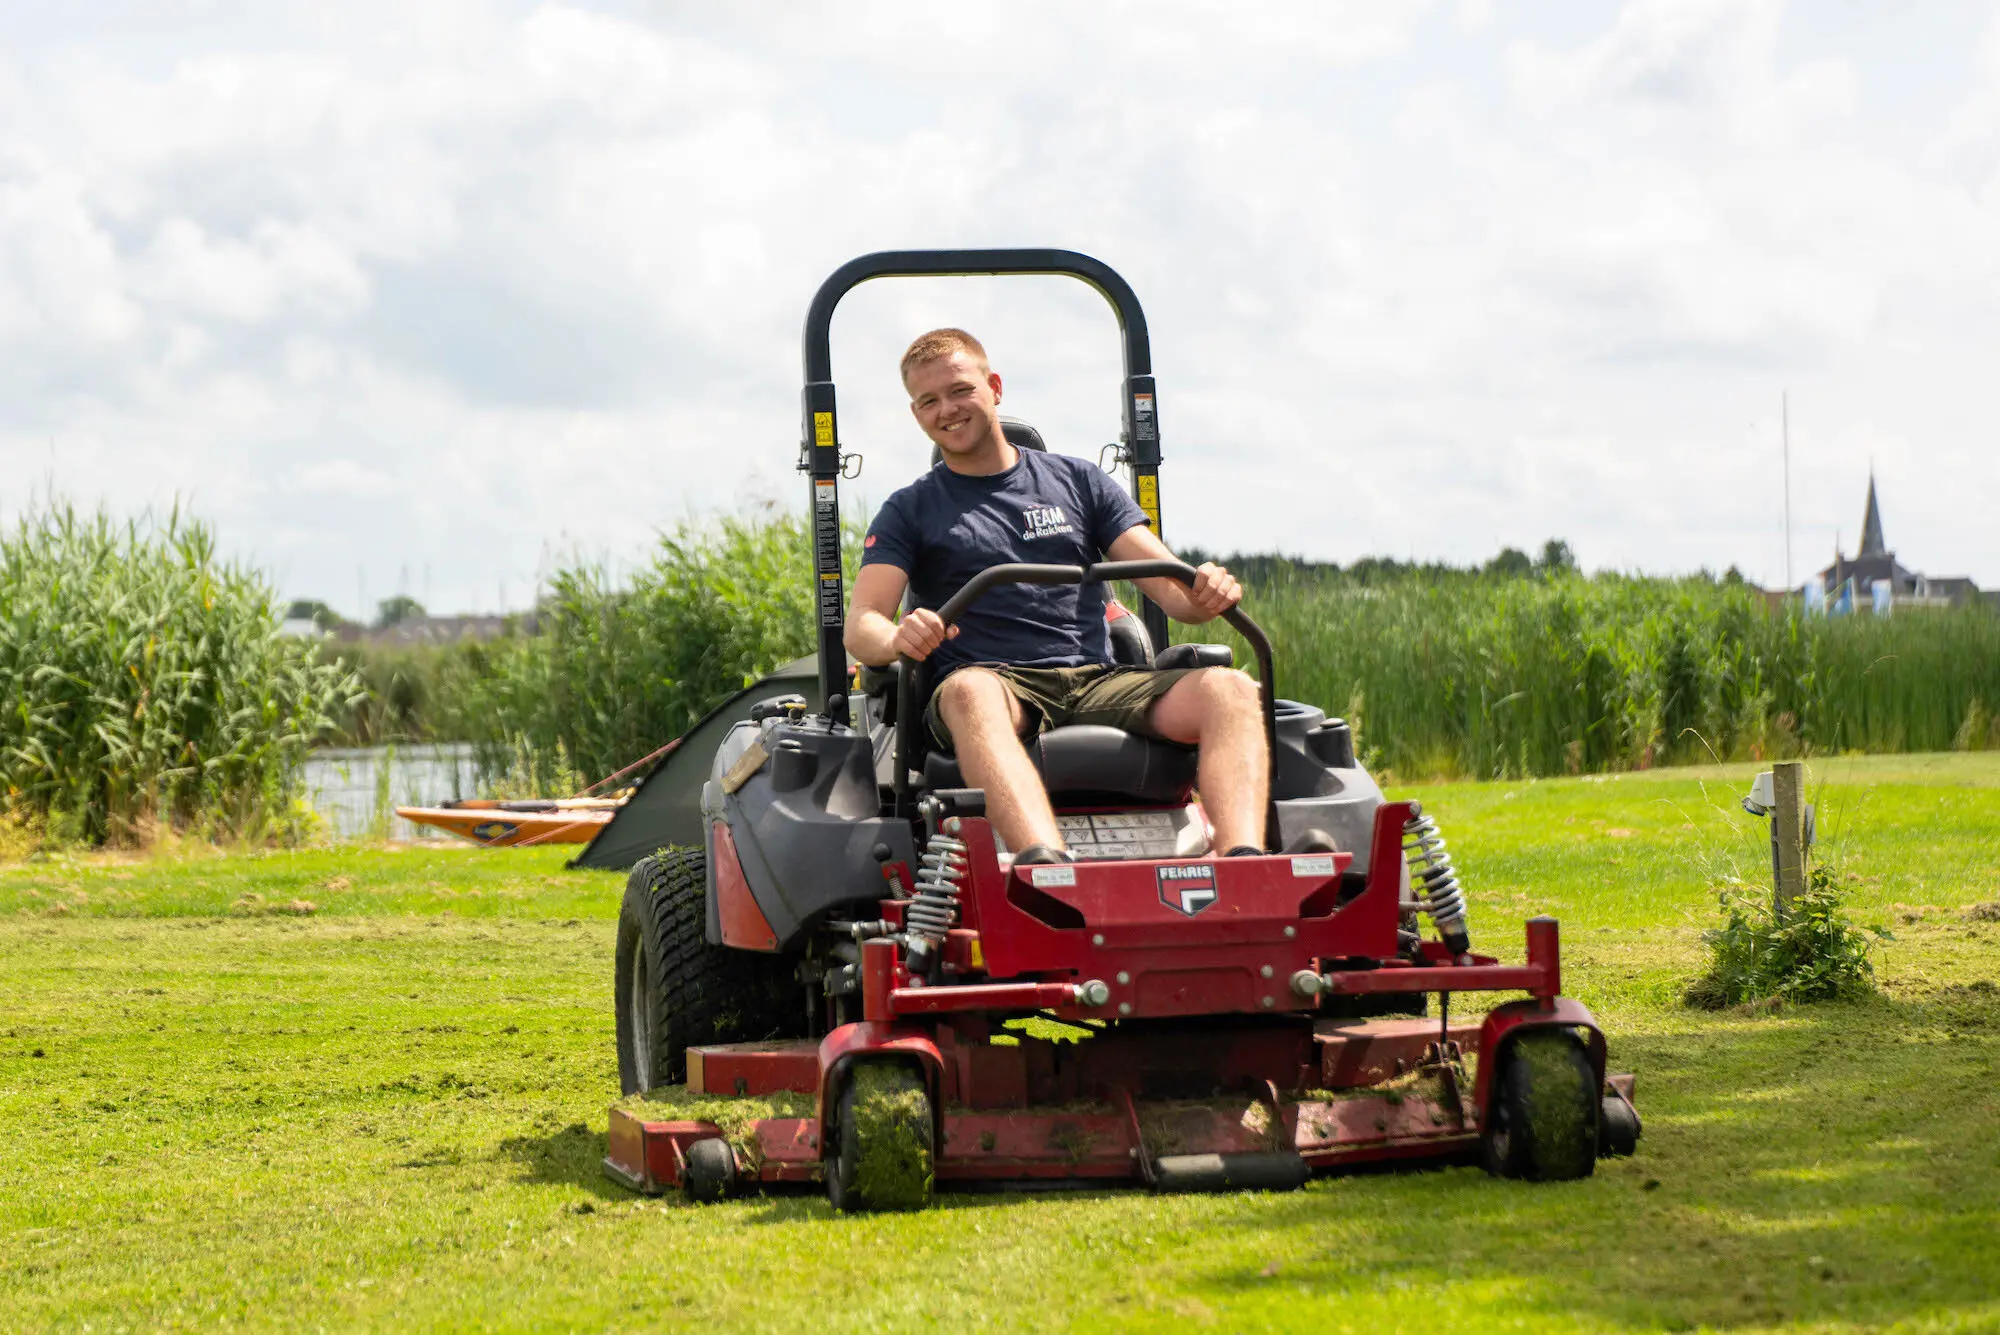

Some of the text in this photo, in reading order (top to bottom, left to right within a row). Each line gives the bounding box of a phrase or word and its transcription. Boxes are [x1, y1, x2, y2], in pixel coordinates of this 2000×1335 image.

[1023, 506, 1066, 529] TEAM
[1022, 523, 1073, 541] de Rakken
